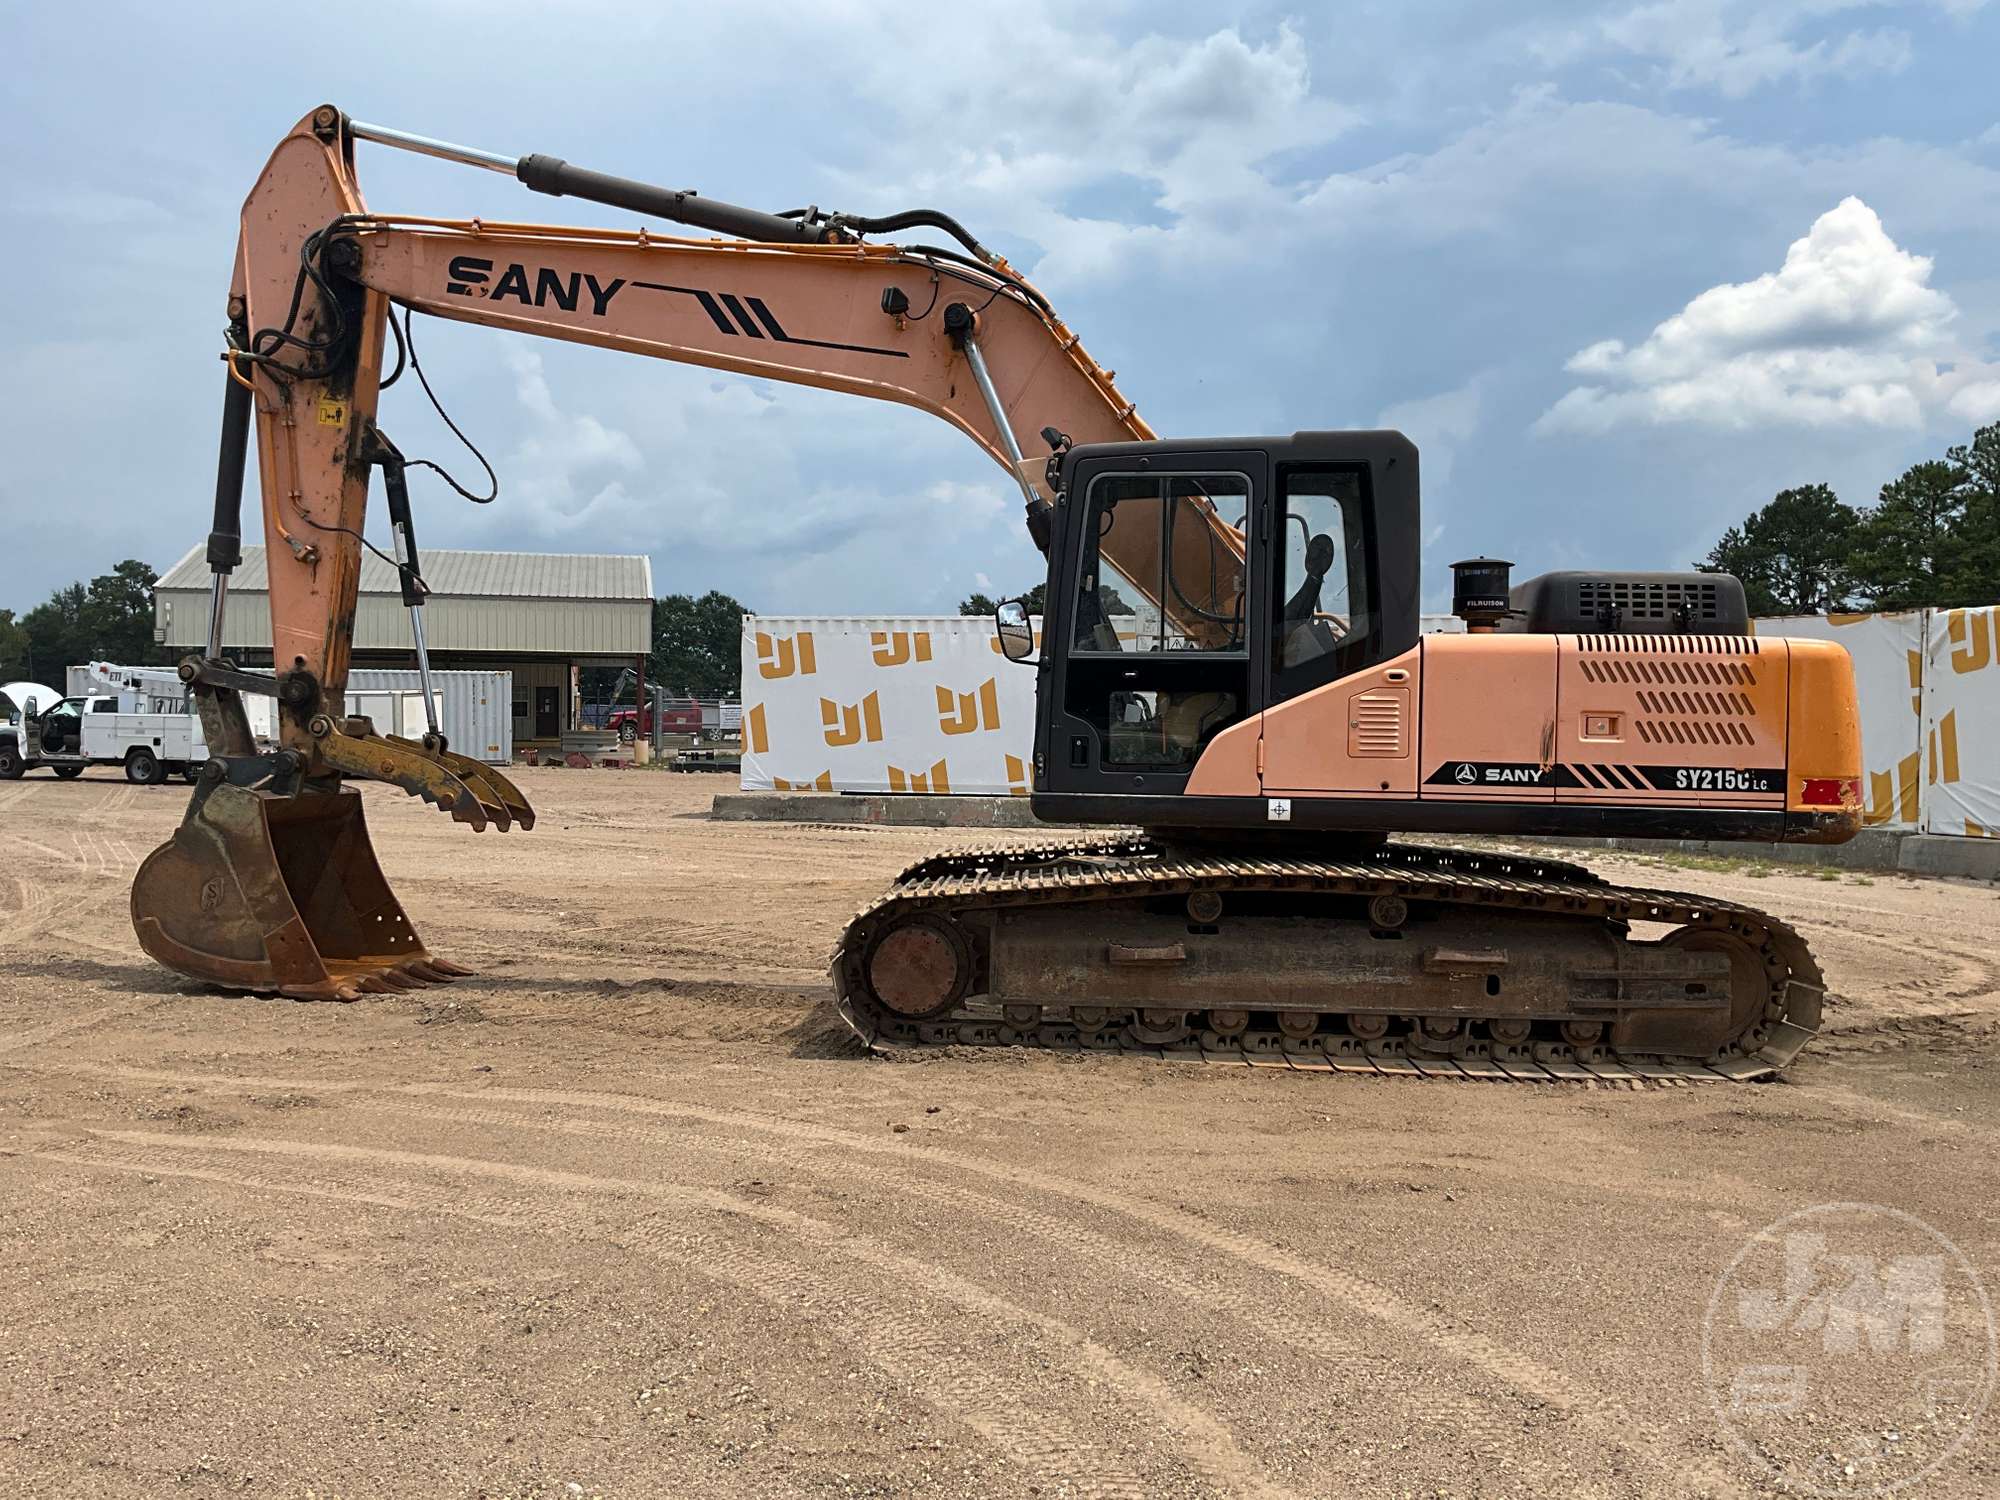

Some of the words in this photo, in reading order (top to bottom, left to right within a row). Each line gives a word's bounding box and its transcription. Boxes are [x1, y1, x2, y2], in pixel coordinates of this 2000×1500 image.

[447, 256, 627, 317] SANY
[109, 671, 121, 681] ETI
[1485, 768, 1543, 782] SANY
[1676, 769, 1750, 790] SY215C
